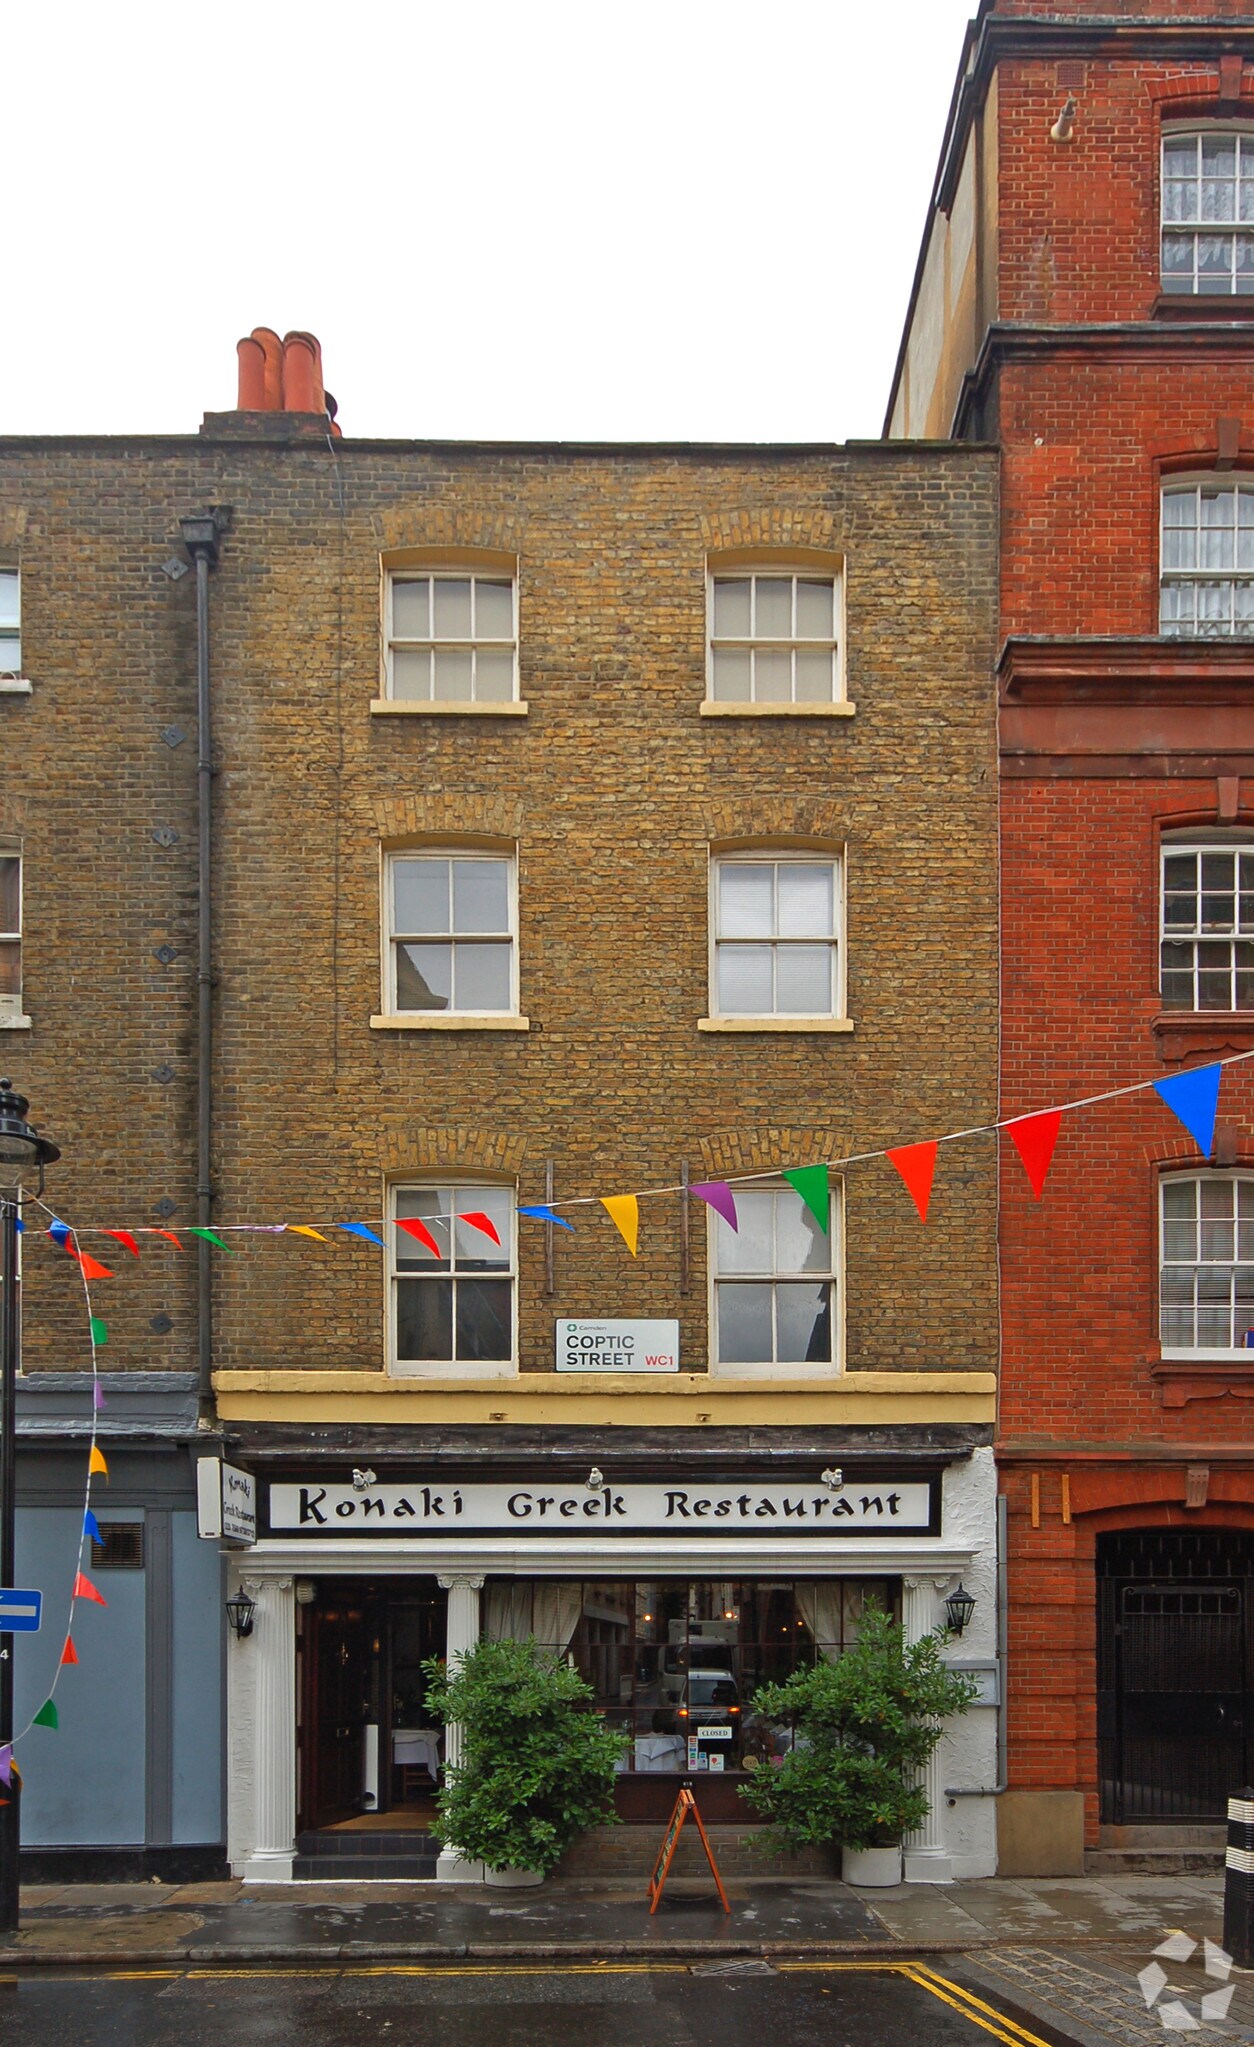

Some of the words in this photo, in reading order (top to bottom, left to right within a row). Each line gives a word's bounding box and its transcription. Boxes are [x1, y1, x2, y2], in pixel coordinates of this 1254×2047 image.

[566, 1335, 635, 1349] COPTIC
[566, 1352, 635, 1366] STREET
[645, 1355, 674, 1366] WC1
[299, 1487, 463, 1525] Konaki
[507, 1487, 627, 1518] Greek
[663, 1492, 902, 1518] Restaurant
